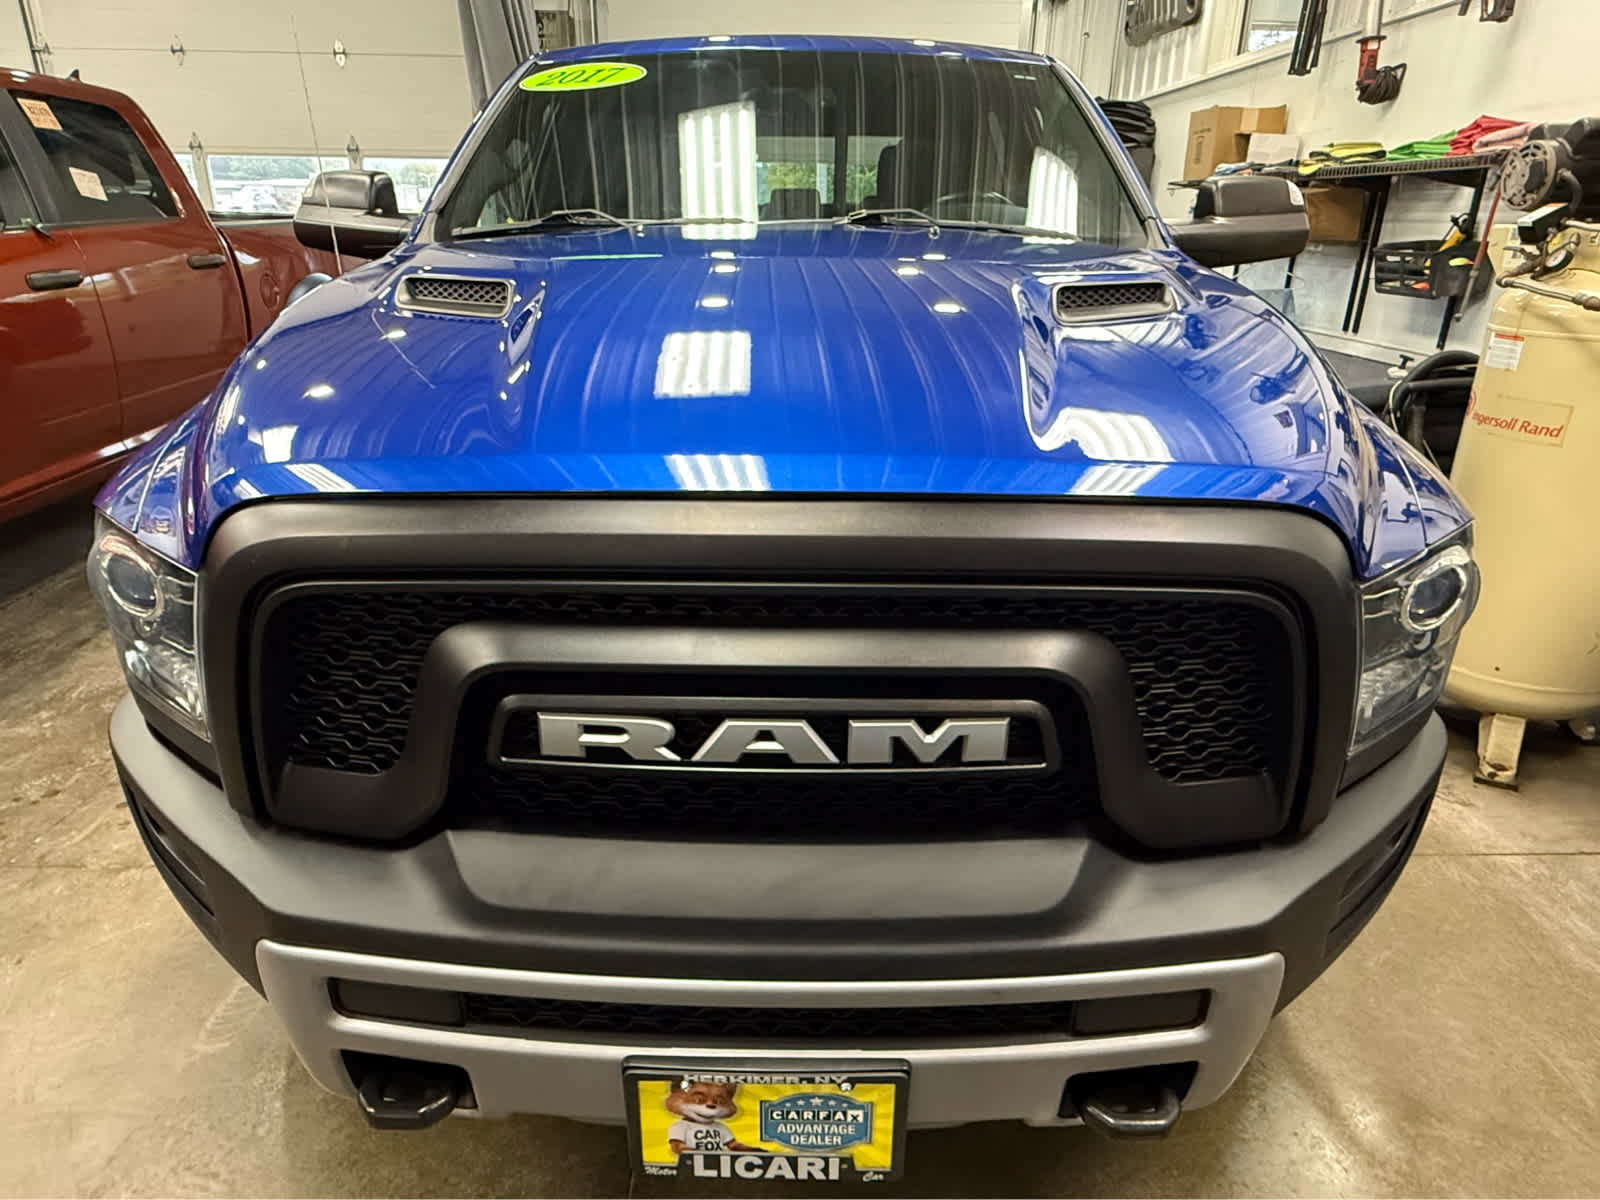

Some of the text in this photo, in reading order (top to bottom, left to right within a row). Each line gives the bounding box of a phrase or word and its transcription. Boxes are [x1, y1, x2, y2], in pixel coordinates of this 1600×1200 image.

[536, 67, 626, 87] 2017
[1519, 420, 1564, 438] Rand
[537, 712, 1010, 764] RAM
[814, 1073, 850, 1086] NY
[770, 1109, 863, 1122] CARFAX
[694, 1130, 721, 1141] CAR
[777, 1123, 856, 1135] ADVANTAGE
[695, 1141, 723, 1152] FOX
[790, 1134, 842, 1146] DEALER
[693, 1154, 841, 1181] LICARI
